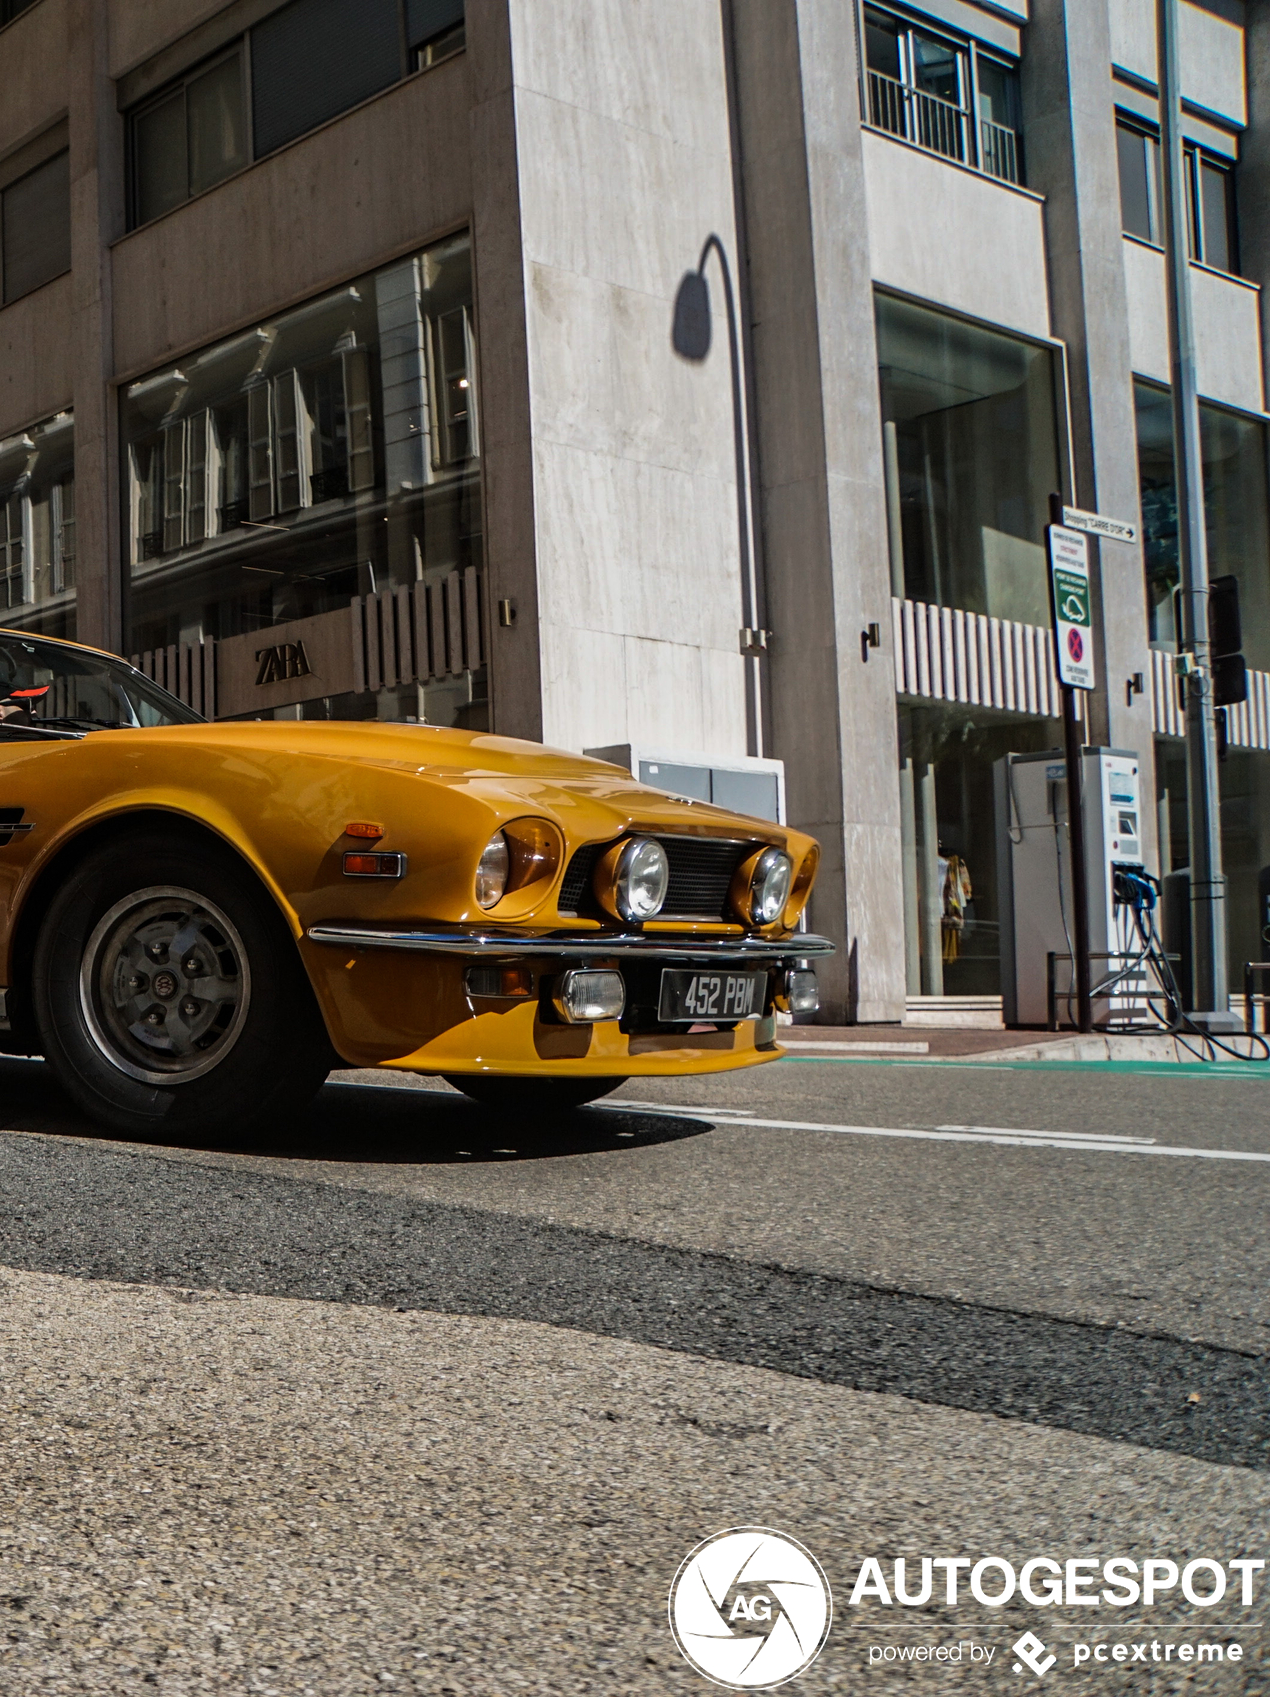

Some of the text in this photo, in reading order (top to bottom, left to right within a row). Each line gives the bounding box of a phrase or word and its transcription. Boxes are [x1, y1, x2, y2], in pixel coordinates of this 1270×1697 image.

[255, 640, 311, 685] ZARA
[685, 976, 755, 1014] 452 PBM
